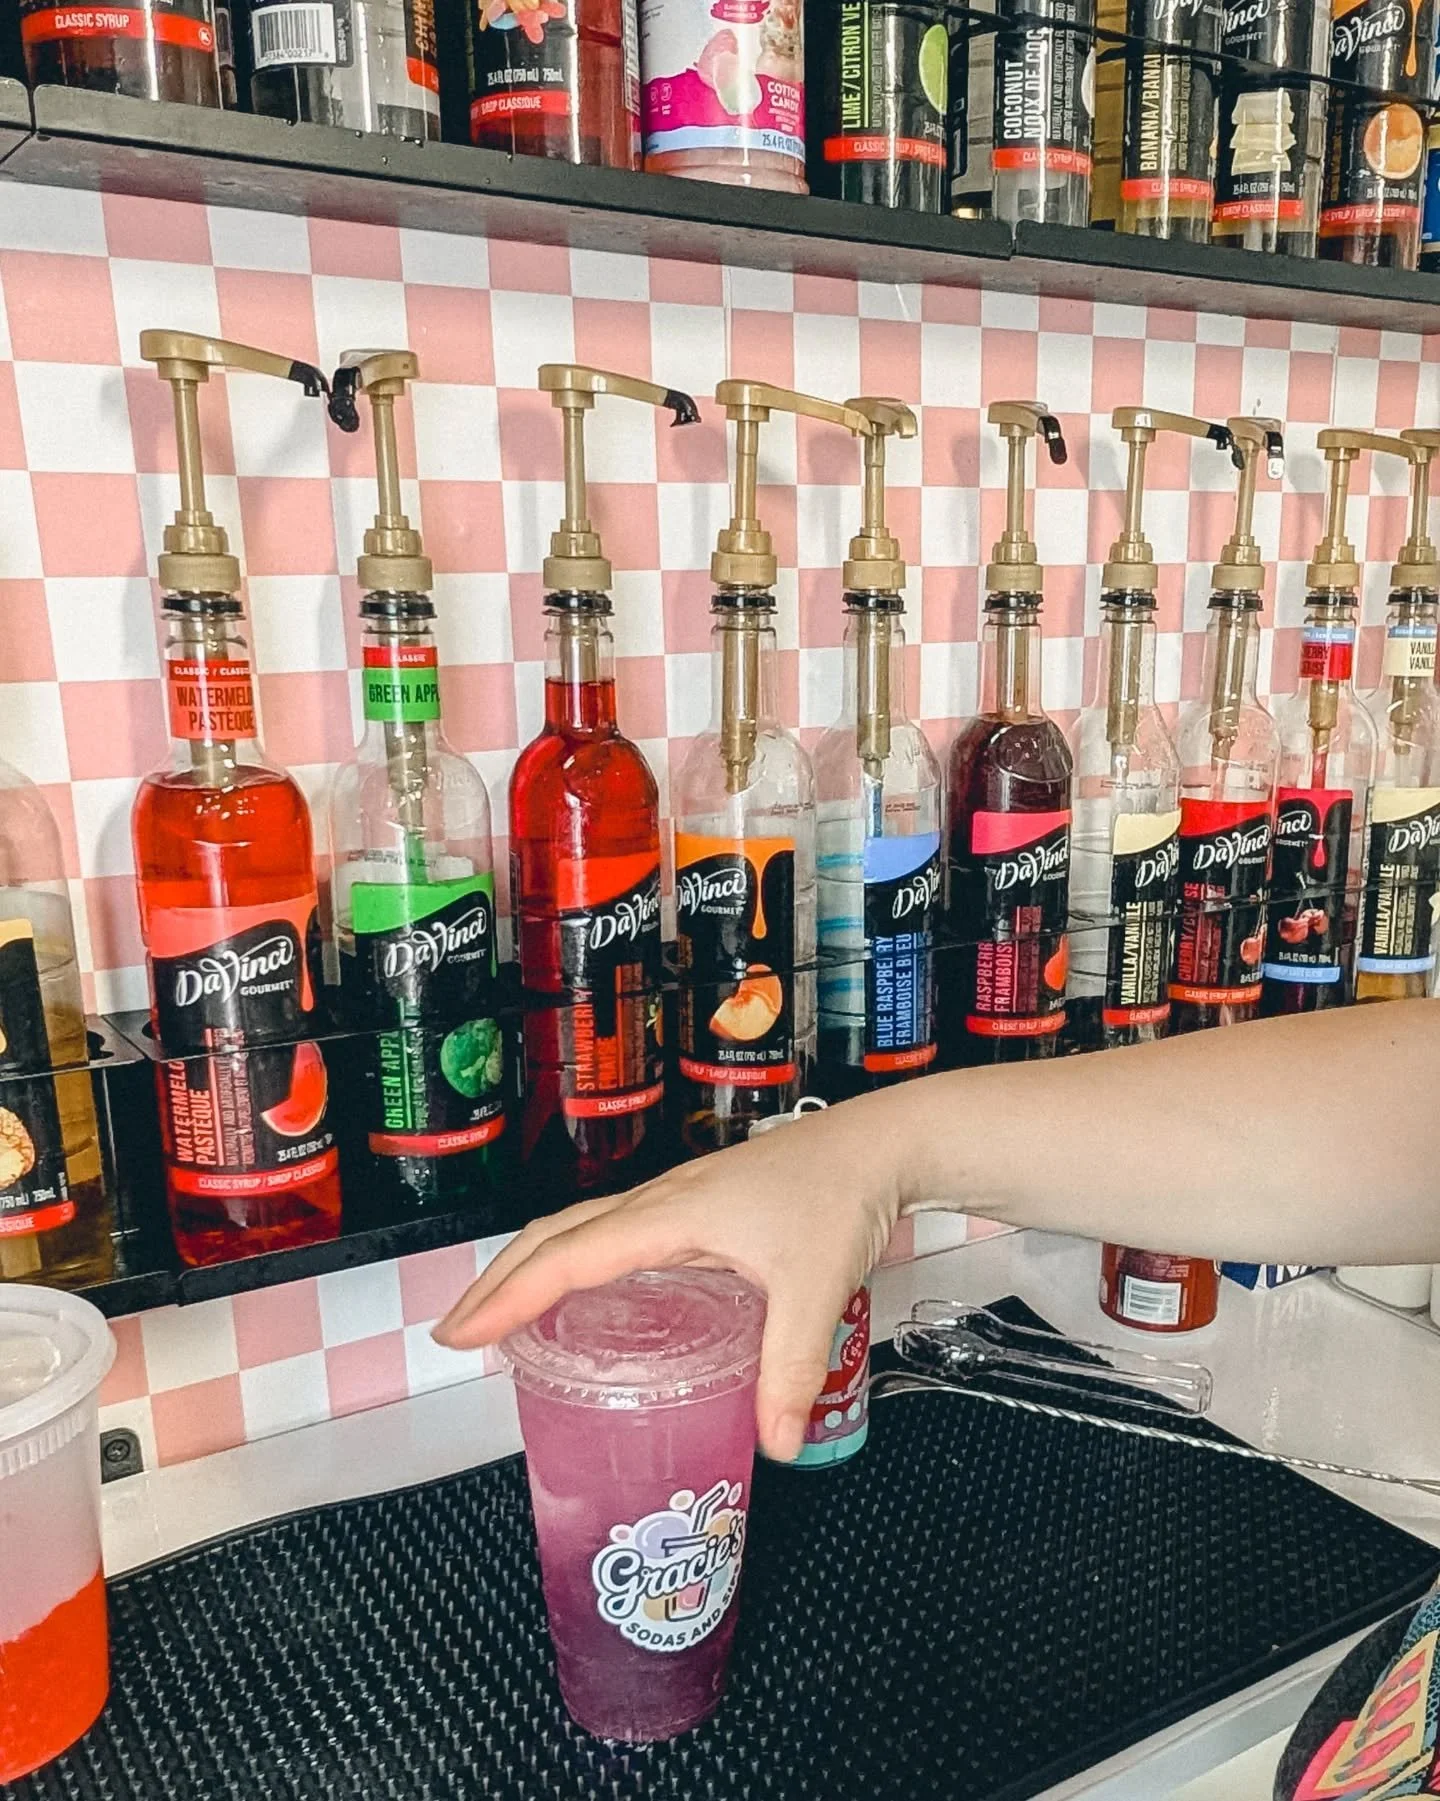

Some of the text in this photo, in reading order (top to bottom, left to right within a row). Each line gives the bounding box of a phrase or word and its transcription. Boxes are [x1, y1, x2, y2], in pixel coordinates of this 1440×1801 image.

[55, 13, 129, 29] CLASSIC SYRUP
[767, 82, 800, 98] COTTON
[771, 96, 799, 113] CANDY
[1004, 60, 1024, 140] COCONUT
[369, 684, 411, 703] GREEN
[384, 907, 488, 978] DaVinci
[175, 934, 295, 1007] DaVinci
[240, 979, 294, 996] GOURMET
[895, 970, 912, 1047] FRAMBOISE
[877, 1013, 893, 1048] BLUE
[382, 1075, 405, 1130] GREEN
[626, 1621, 687, 1647] SODAS
[691, 1607, 721, 1641] AND
